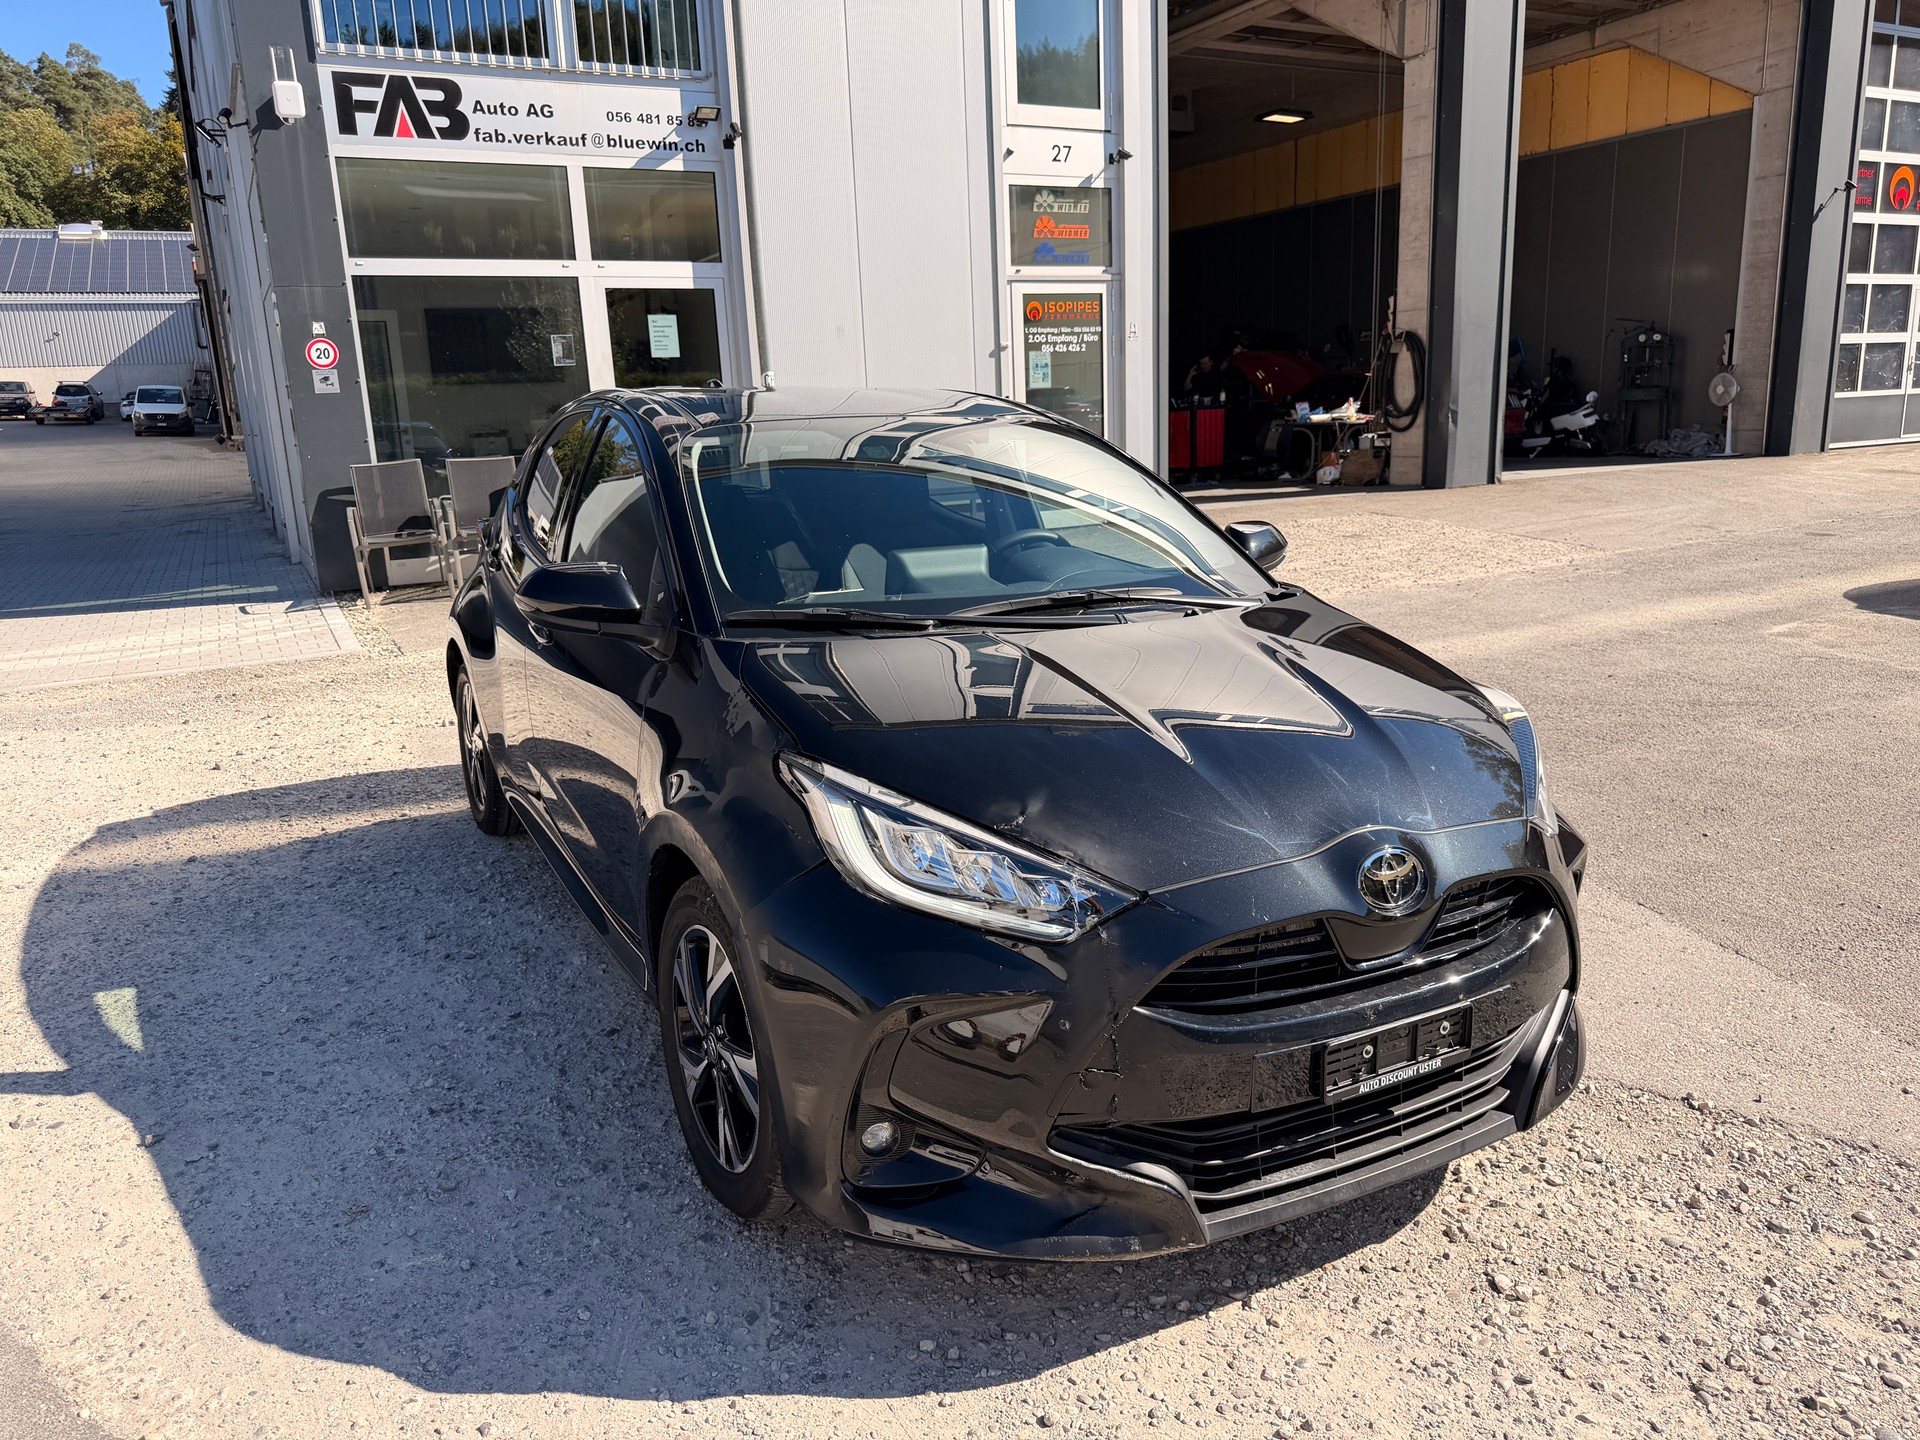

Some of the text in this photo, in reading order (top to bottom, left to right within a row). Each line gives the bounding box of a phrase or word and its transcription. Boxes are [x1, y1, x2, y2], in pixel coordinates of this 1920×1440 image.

[331, 71, 470, 141] FAB
[472, 100, 554, 118] Auto AG
[606, 111, 632, 123] 056
[637, 113, 661, 125] 481
[666, 115, 683, 126] 85
[1052, 145, 1072, 162] 27
[1044, 301, 1100, 313] ISOPIPES
[1047, 334, 1078, 344] Empfang
[315, 348, 330, 359] 20
[1041, 344, 1054, 353] 056
[1081, 343, 1087, 352] 2
[1359, 1059, 1442, 1094] AUTO DISCOUNT USTER
